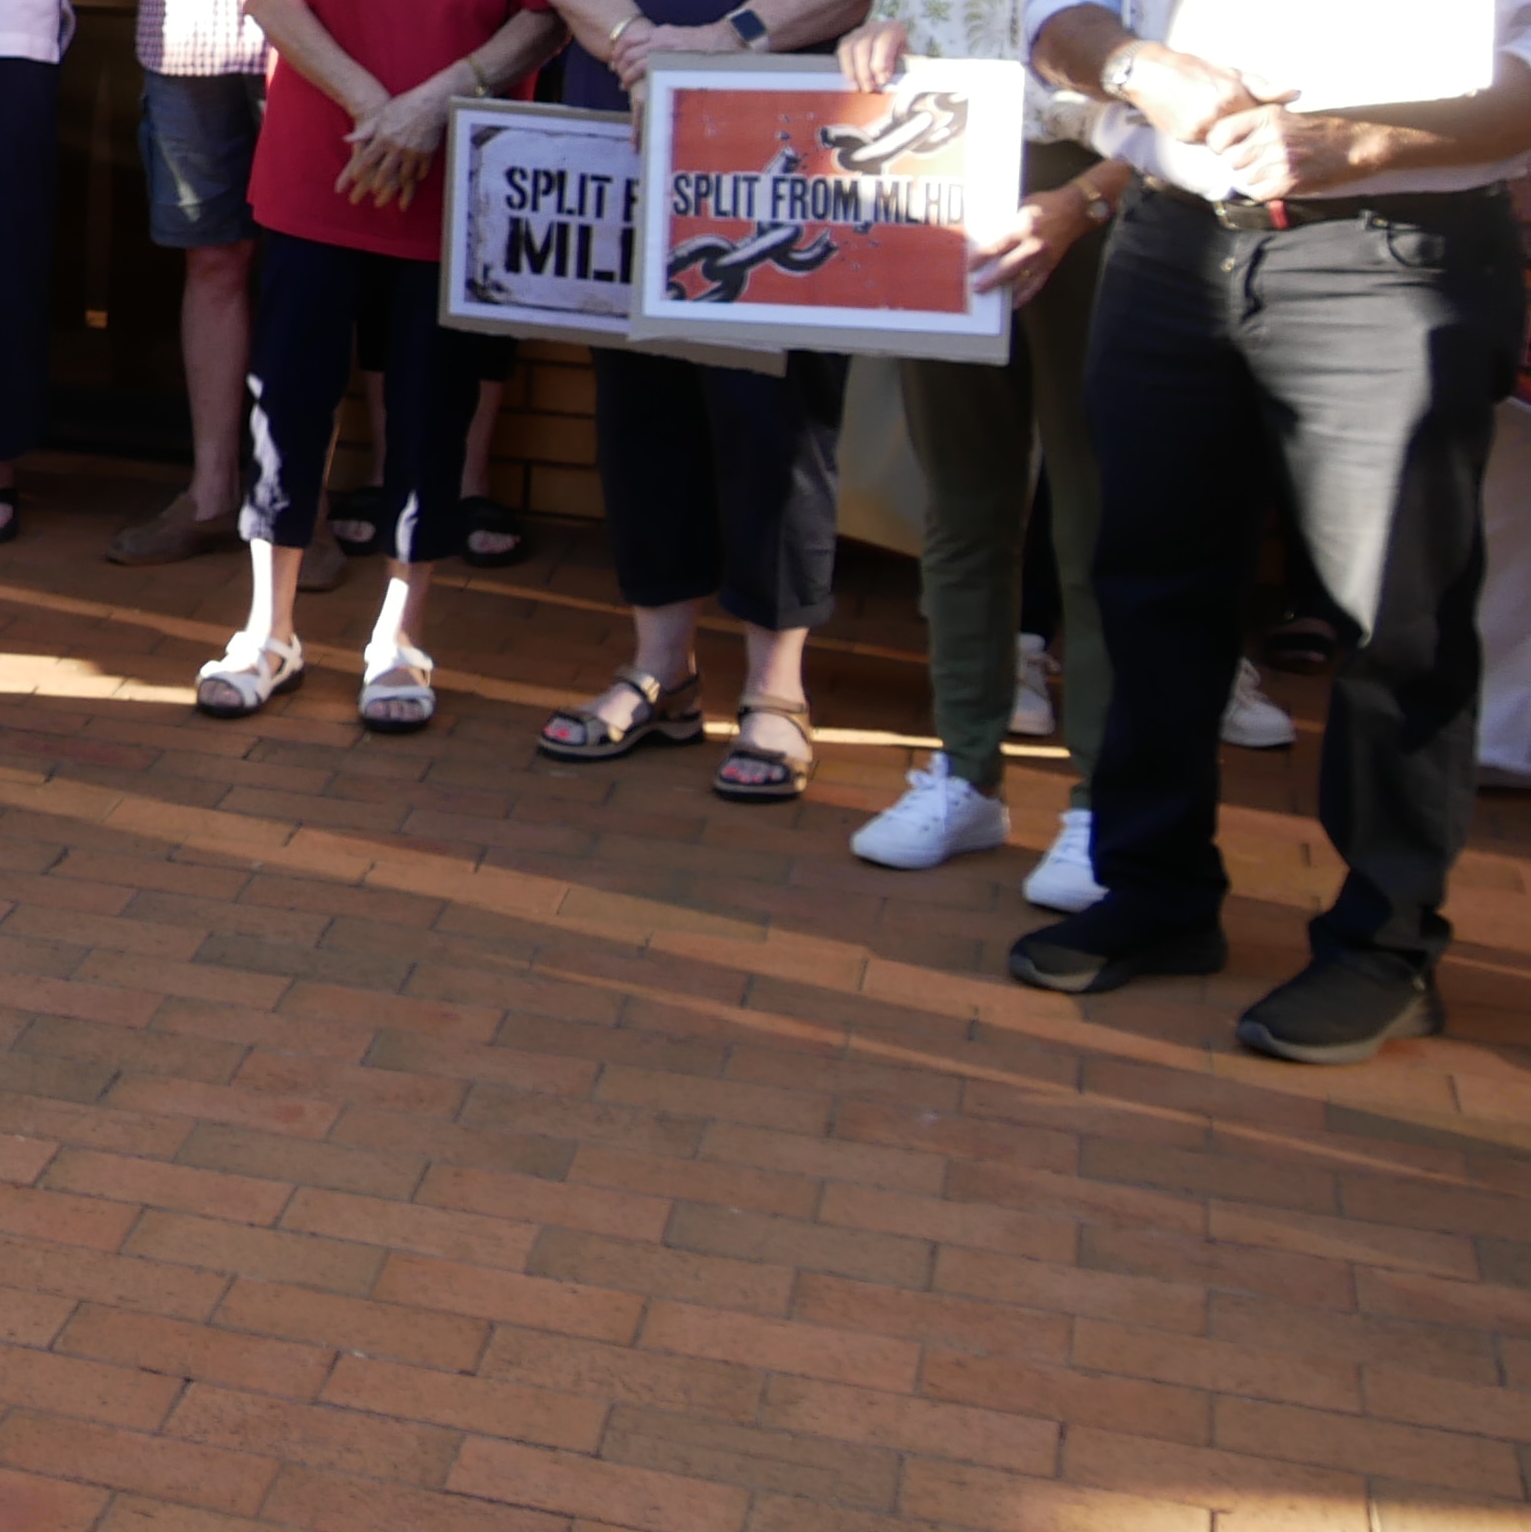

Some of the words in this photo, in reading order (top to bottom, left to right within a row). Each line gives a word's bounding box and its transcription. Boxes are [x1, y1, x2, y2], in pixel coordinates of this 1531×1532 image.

[504, 166, 614, 219] SPLIT
[672, 173, 760, 218] SPLIT
[771, 175, 862, 221] FROM
[873, 177, 964, 225] MLHD
[504, 216, 635, 285] ML
